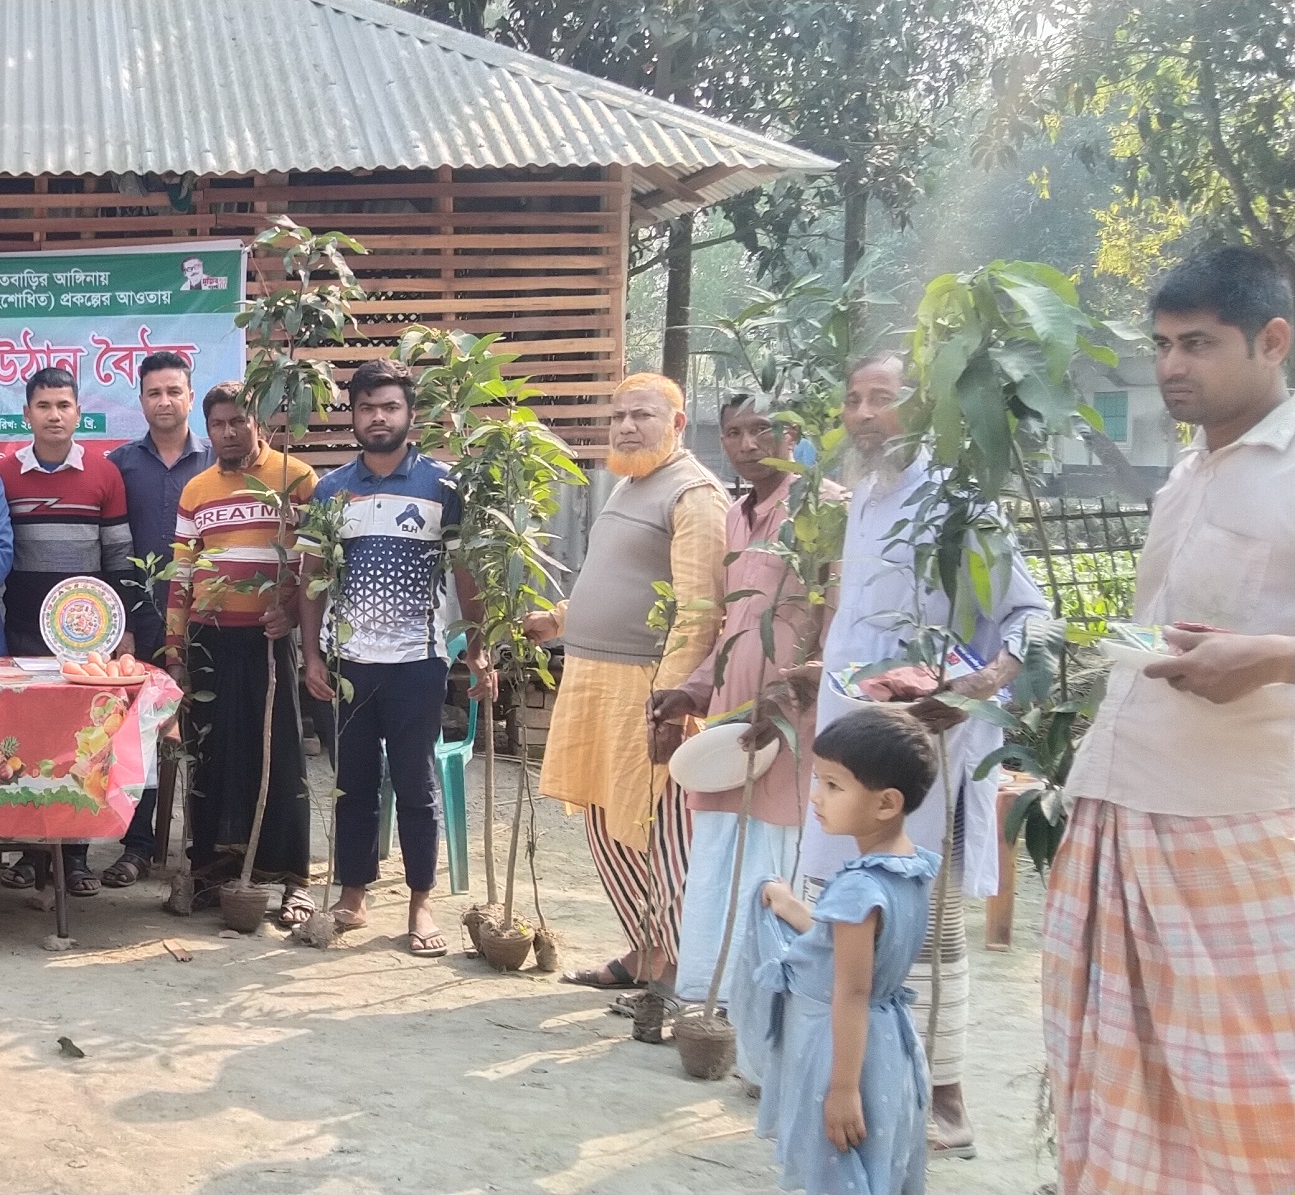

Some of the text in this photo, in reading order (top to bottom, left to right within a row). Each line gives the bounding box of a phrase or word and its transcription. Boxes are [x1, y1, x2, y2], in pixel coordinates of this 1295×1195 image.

[53, 268, 110, 287] আঙ্গিনায়
[60, 291, 112, 308] প্রকল্পের
[115, 290, 173, 306] আওতায়
[195, 504, 289, 530] GREATM
